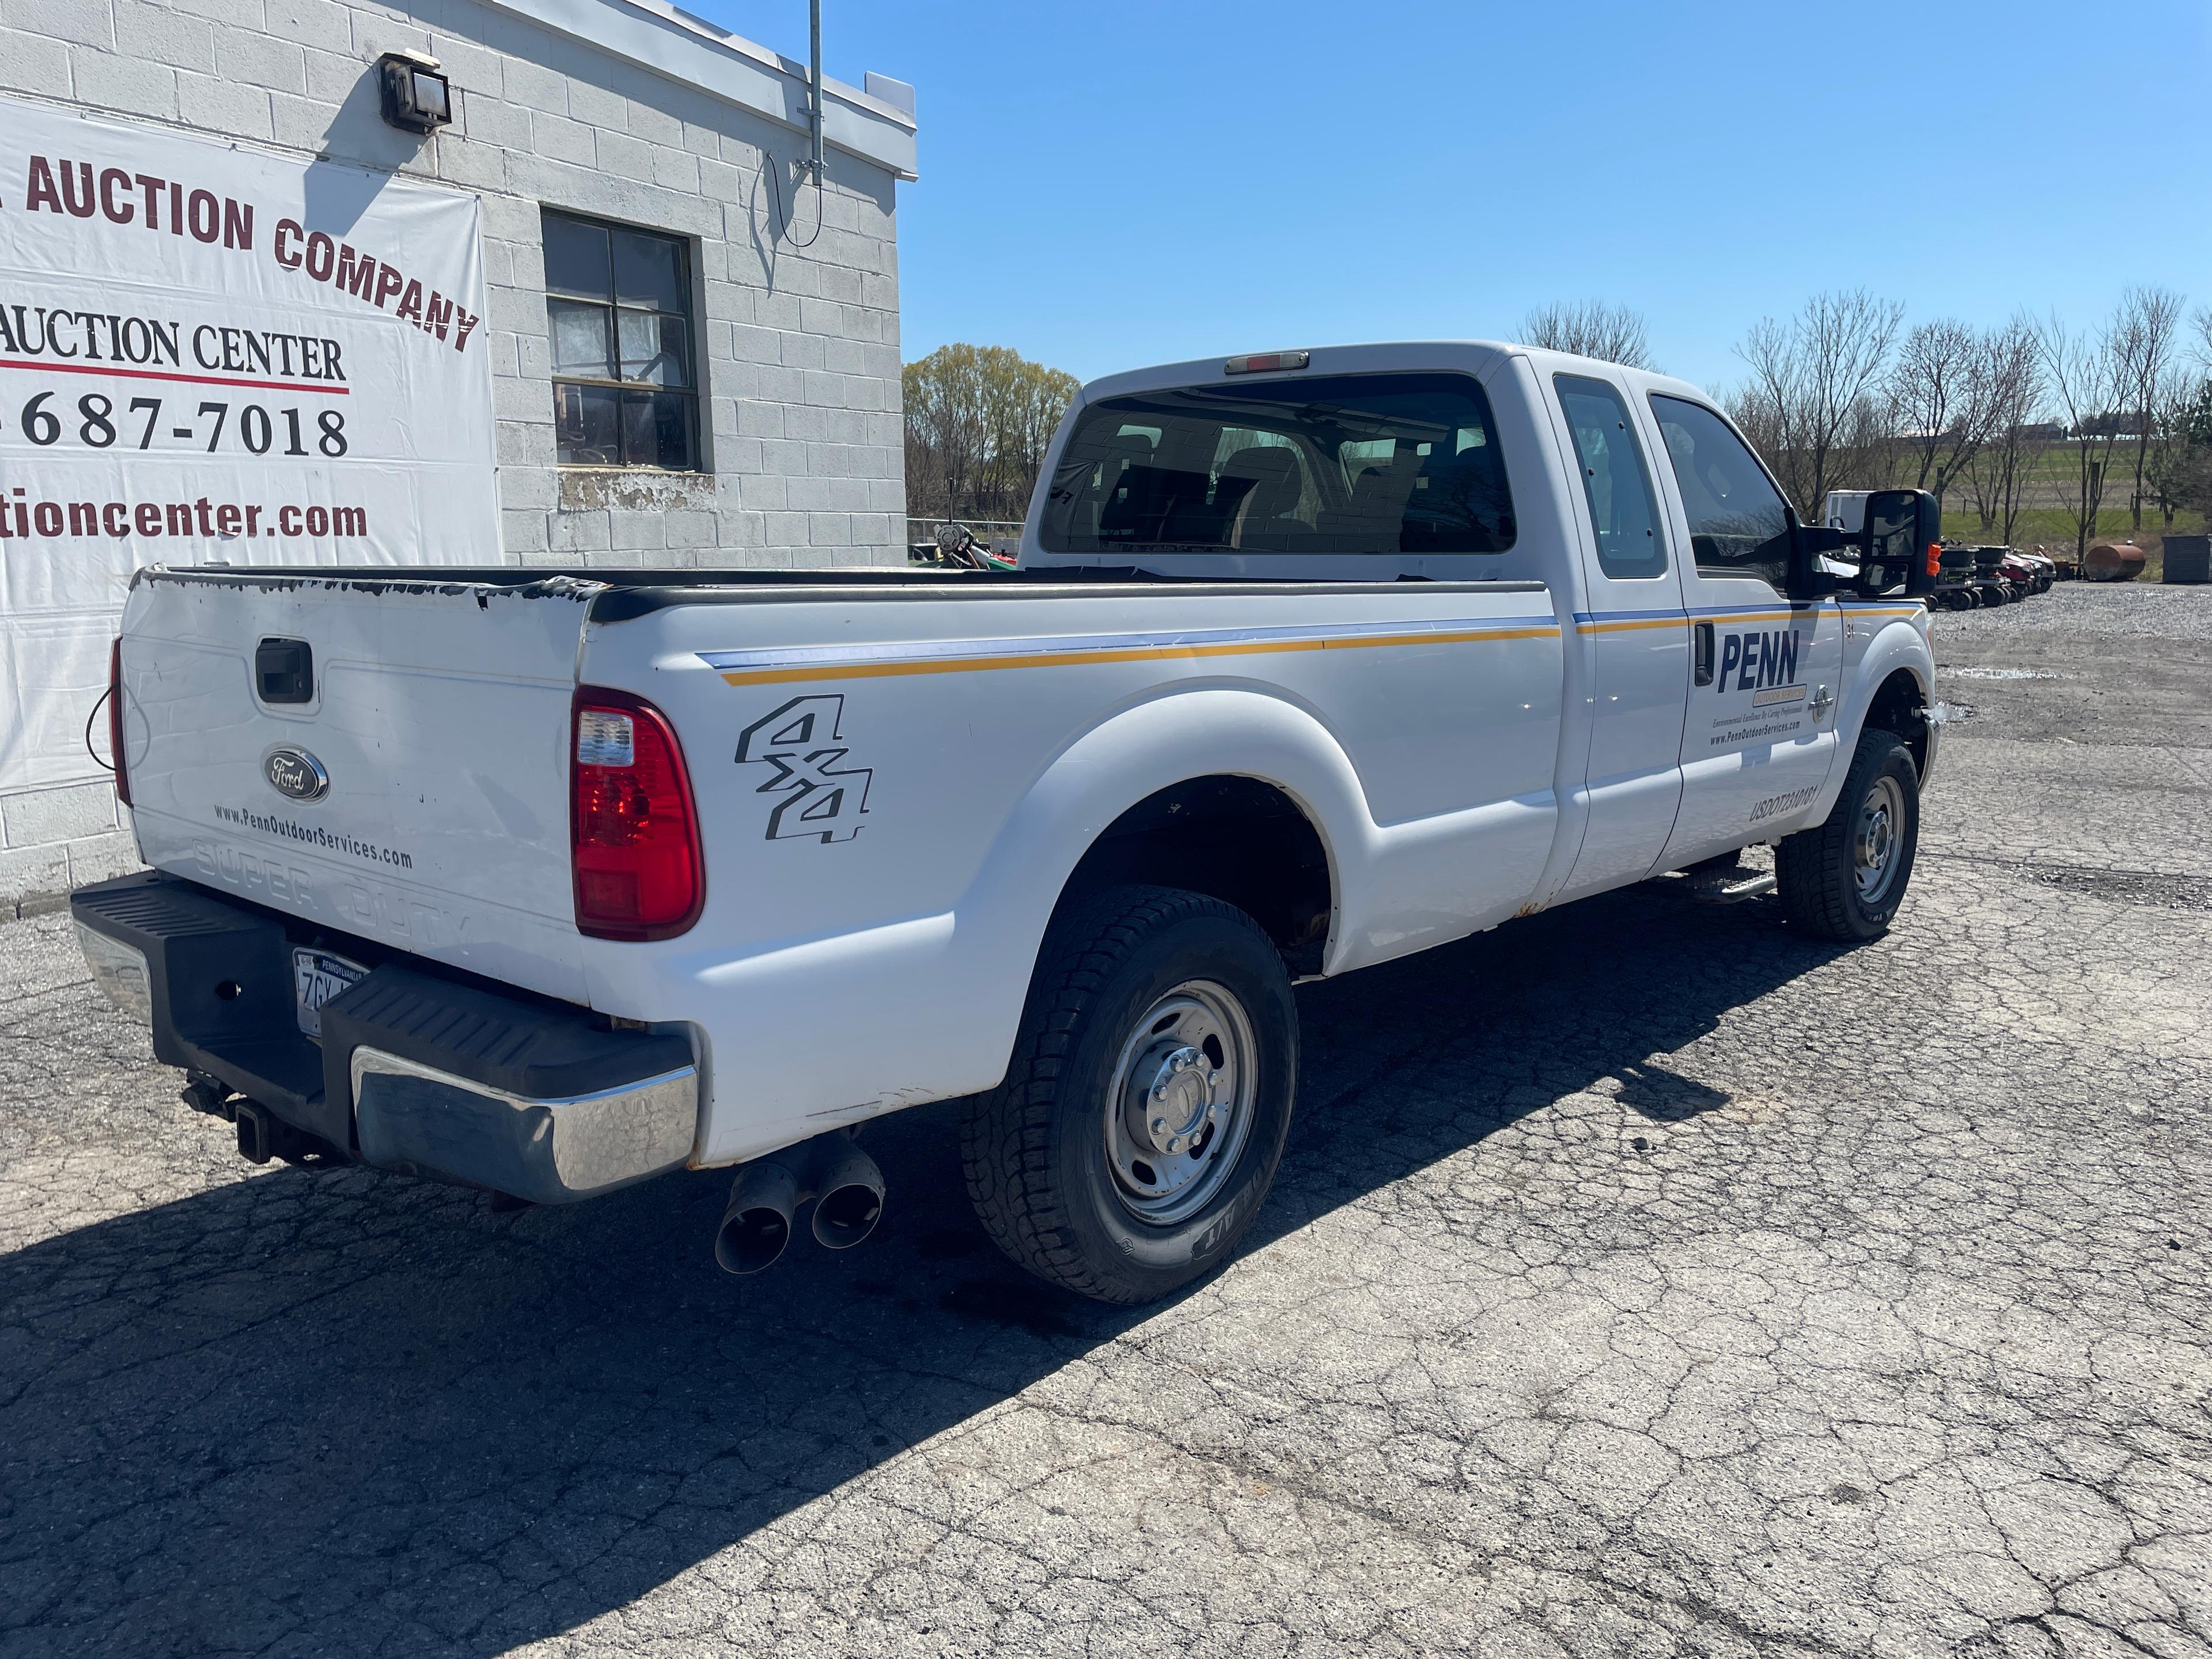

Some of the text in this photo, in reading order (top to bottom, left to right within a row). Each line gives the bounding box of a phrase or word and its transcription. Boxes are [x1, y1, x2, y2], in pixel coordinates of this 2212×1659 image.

[26, 155, 479, 353] AUCTION COMPANY
[193, 324, 347, 381] CENTER
[0, 391, 348, 457] 687-7018
[0, 487, 367, 537] tioncenter.com
[1847, 624, 1854, 638] 31
[1718, 630, 1799, 693] PENN
[1755, 688, 1804, 704] OUTDOOR SERVICES
[1710, 721, 1800, 745] www.PennOutdoorServices.com
[1713, 715, 1742, 728] Environmental
[272, 757, 304, 791] Ford
[1749, 784, 1818, 822] USDOT2310181
[214, 804, 413, 869] www.PennOutdoorServices.com
[192, 838, 471, 955] SUPER DUTY
[322, 959, 359, 980] PENNSYLVANIA
